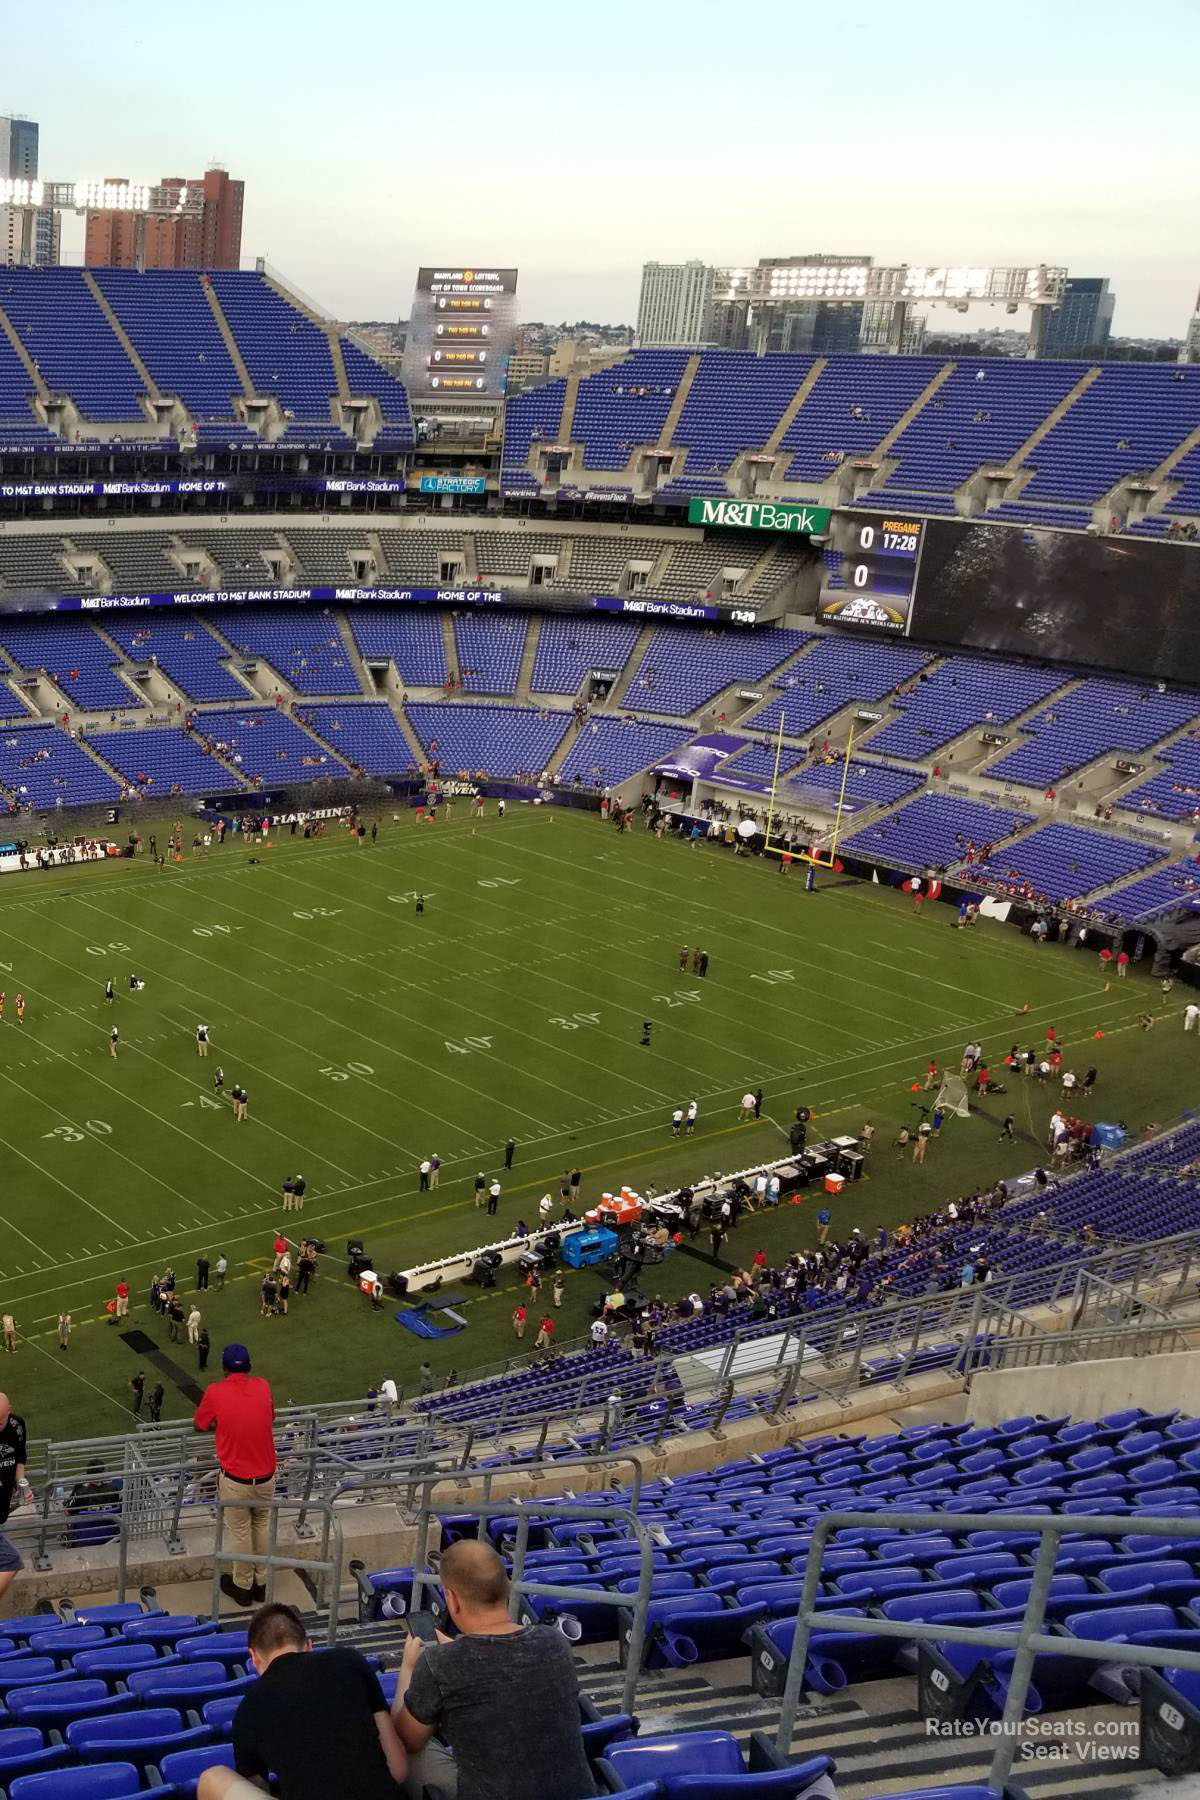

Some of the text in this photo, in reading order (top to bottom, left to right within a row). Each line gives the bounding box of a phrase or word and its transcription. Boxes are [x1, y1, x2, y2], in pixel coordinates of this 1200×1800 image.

[103, 482, 170, 494] M&T Bank Stadium
[178, 482, 216, 492] HOME OF
[326, 480, 399, 491] M&T Bank Stadium
[437, 478, 481, 486] STRATEGIC
[437, 484, 481, 492] FACTORY
[1, 486, 14, 496] TO
[15, 486, 33, 496] M&T
[34, 486, 57, 496] BANK
[58, 484, 94, 495] STADIUM
[505, 489, 537, 497] RAVENS
[584, 492, 628, 503] #RavensFlock
[701, 500, 816, 532] M&T Bank
[860, 520, 920, 549] 0 PREGAME
[884, 534, 917, 552] 17:28
[854, 564, 868, 588] 0
[174, 590, 310, 604] WELCOME TO M&T BANK STADIUM
[335, 589, 411, 600] M&T Bank Stadium
[437, 592, 502, 602] HOME OF THE
[80, 595, 150, 609] M&T Bank Stadium
[623, 600, 705, 617] M&T Bank Stadium
[740, 690, 763, 699] GEICO
[859, 710, 882, 720] GEICO
[476, 876, 515, 888] 10
[386, 890, 424, 904] 20
[292, 906, 335, 920] 30
[191, 924, 232, 938] 40
[85, 942, 132, 956] 50
[749, 969, 796, 985] 10
[651, 990, 703, 1008] 20
[547, 1012, 601, 1030] 30
[444, 1036, 493, 1054] 40
[317, 1062, 375, 1082] 50
[52, 1119, 113, 1143] 30
[361, 1280, 368, 1289] G
[1166, 1709, 1178, 1723] 15
